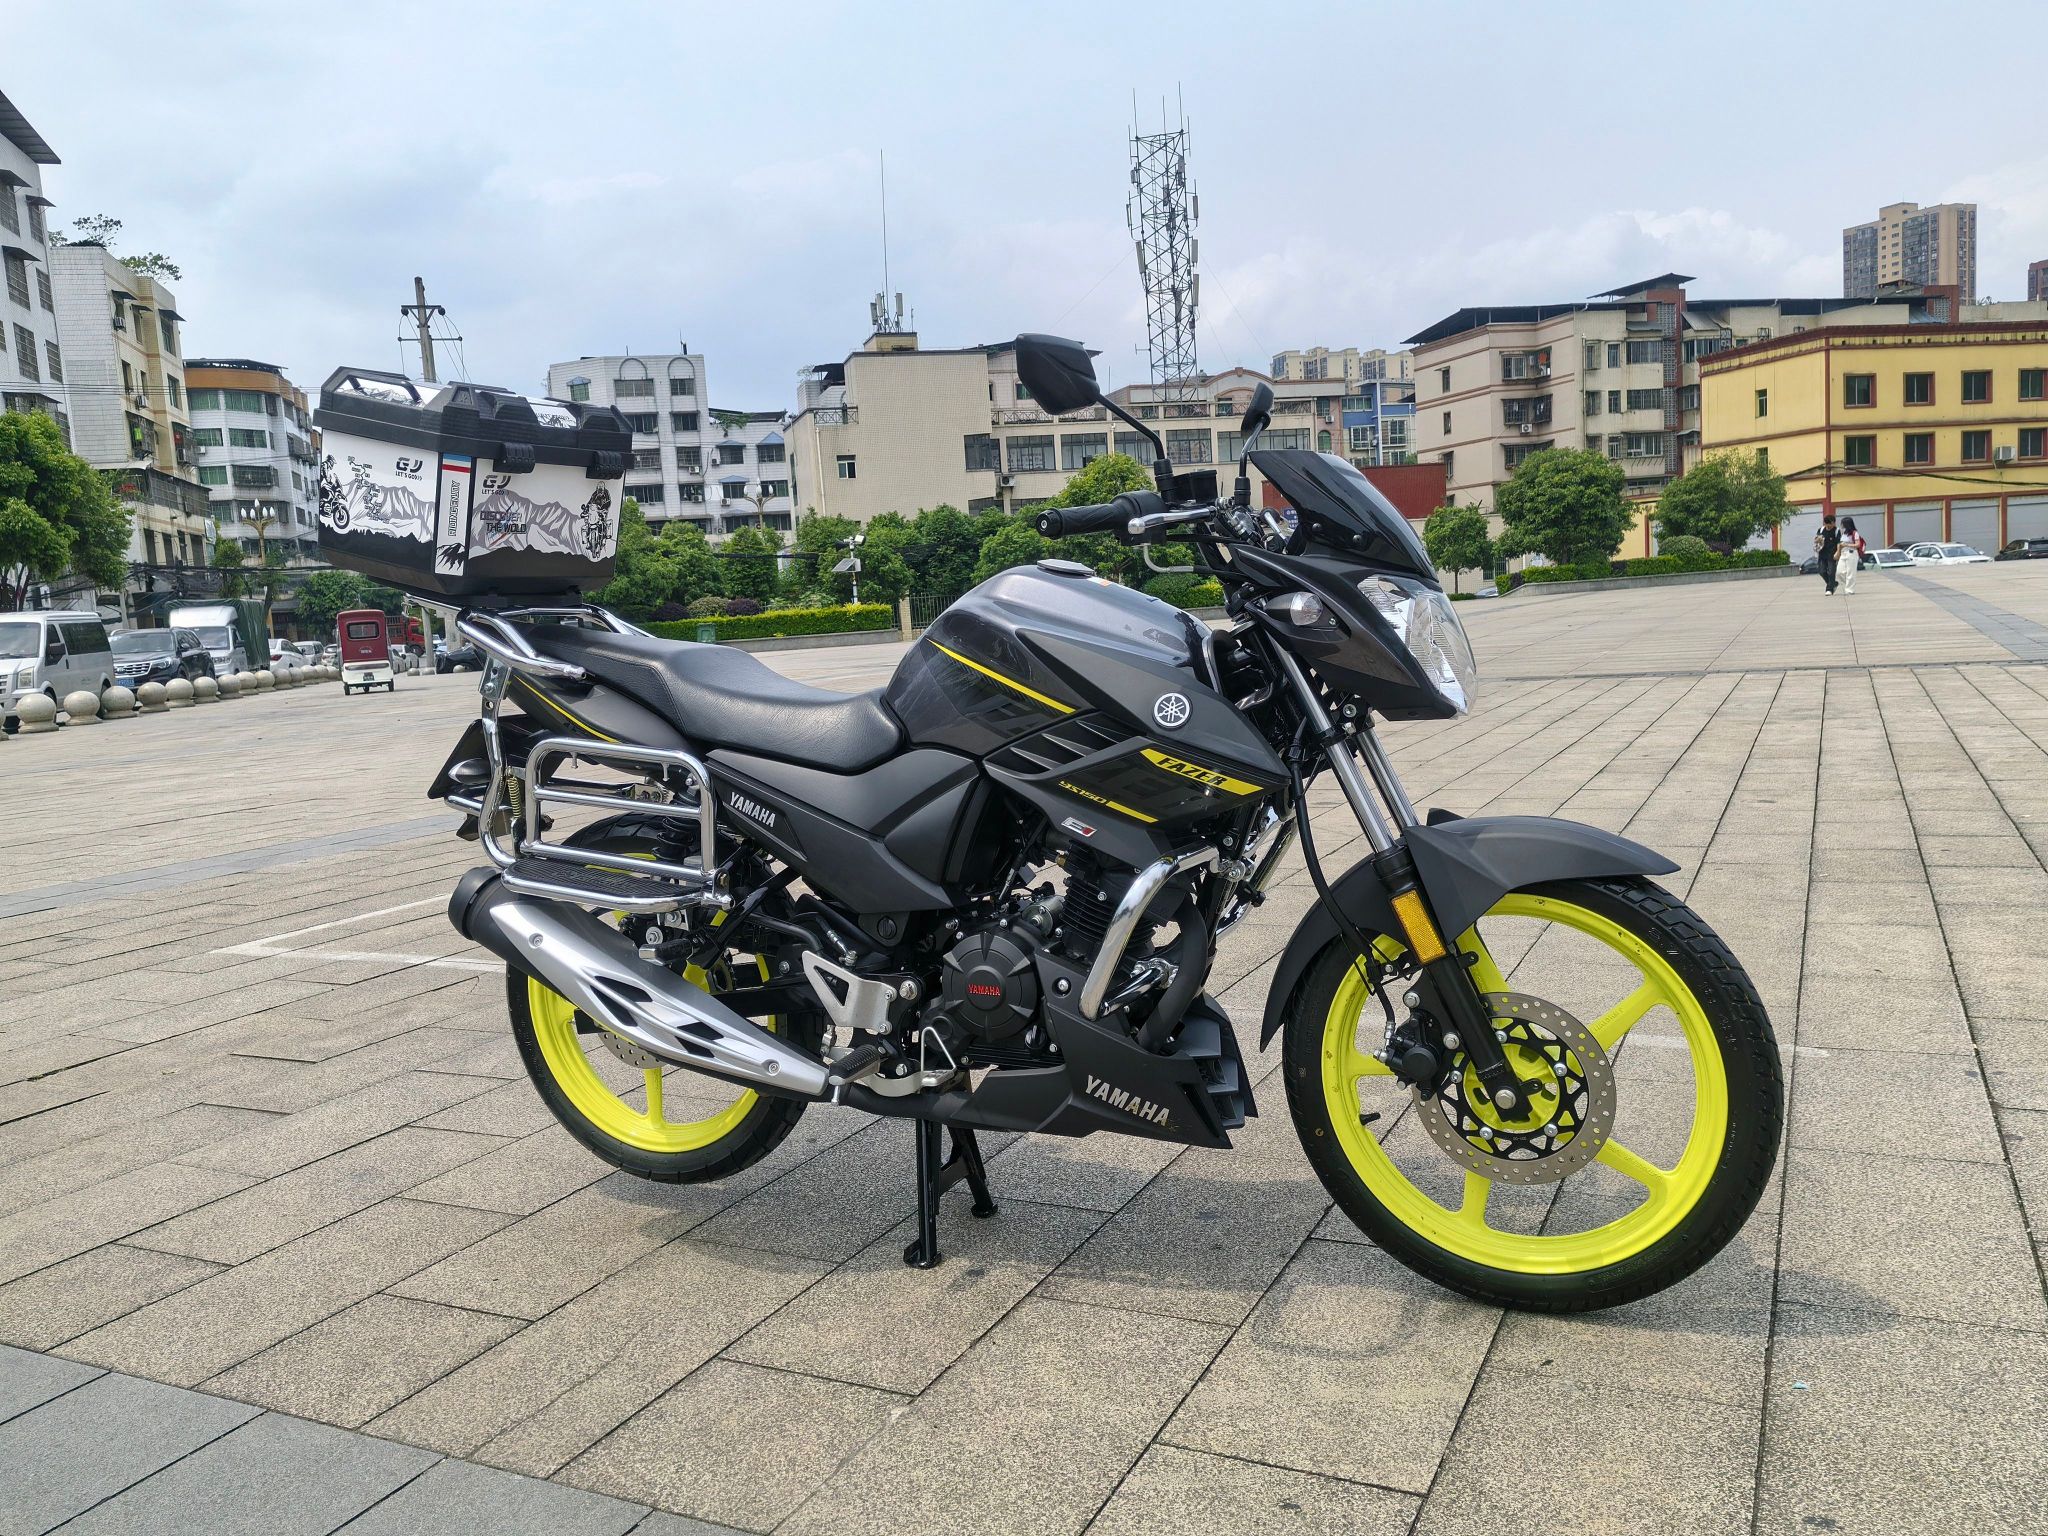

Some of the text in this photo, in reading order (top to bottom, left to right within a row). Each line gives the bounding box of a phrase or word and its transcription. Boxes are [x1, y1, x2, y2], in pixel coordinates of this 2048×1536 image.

[395, 470, 407, 478] LET'S
[480, 511, 522, 522] DISCOVER
[486, 522, 502, 532] THE
[1157, 757, 1228, 785] FAZER
[730, 791, 776, 828] YAMAHA
[968, 984, 1001, 996] YAMAHA
[1085, 1074, 1170, 1127] YAMAHA
